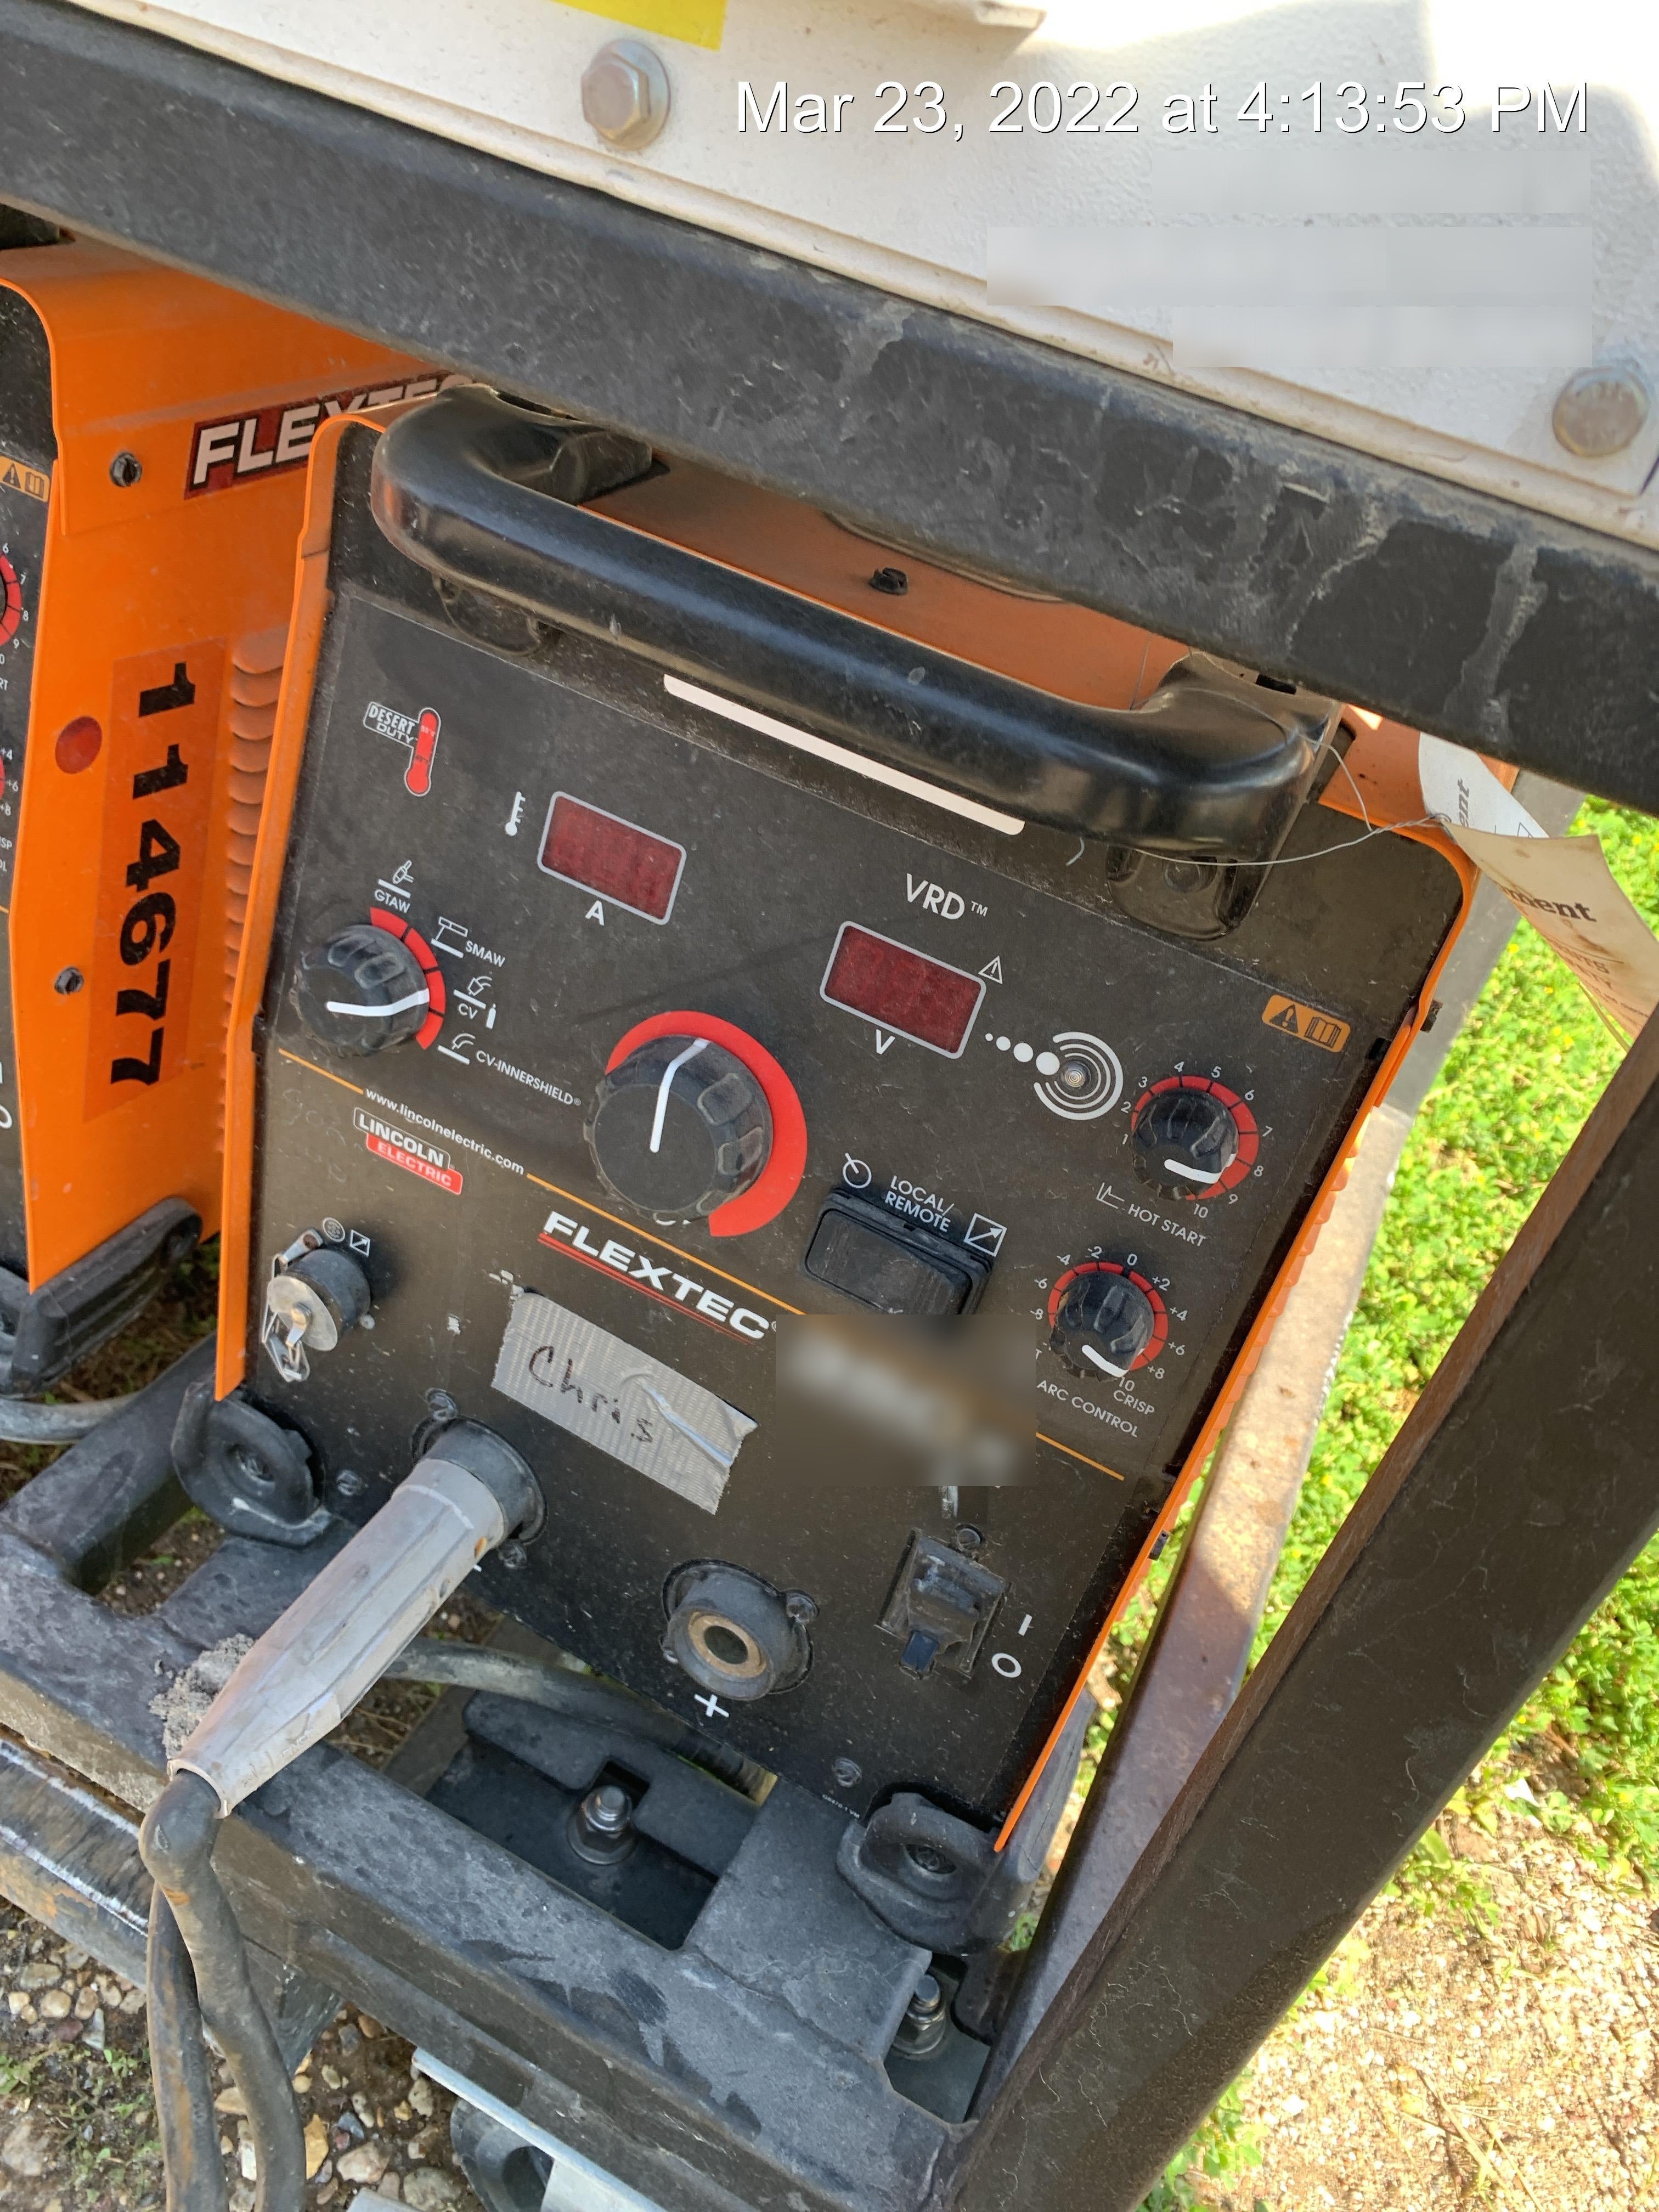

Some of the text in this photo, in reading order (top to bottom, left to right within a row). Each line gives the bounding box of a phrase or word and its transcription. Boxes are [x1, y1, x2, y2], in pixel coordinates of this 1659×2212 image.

[22, 611, 29, 622] 8
[13, 639, 20, 649] 9
[368, 705, 416, 735] DESERT
[111, 660, 196, 1085] 114677
[374, 888, 410, 914] GTAW
[585, 900, 605, 926] A
[465, 940, 506, 968] SMAW
[458, 1003, 478, 1019] CV
[876, 1029, 895, 1054] V
[1173, 1062, 1185, 1073] 4
[1211, 1066, 1222, 1078] 5
[1138, 1076, 1148, 1088] 3
[1244, 1090, 1255, 1101] 6
[1120, 1101, 1131, 1114] 2
[365, 1088, 524, 1175] www.lincolnelectric.com
[1262, 1125, 1273, 1137] 7
[359, 1113, 444, 1168] LINCOLN
[1122, 1133, 1128, 1145] 1
[377, 1141, 452, 1187] ELECTRIC
[1254, 1165, 1264, 1177] 8
[890, 1175, 955, 1216] LOCAL/
[1228, 1193, 1238, 1205] 9
[884, 1190, 951, 1232] REMOTE
[1193, 1203, 1209, 1218] 10
[1128, 1203, 1206, 1247] HOT START
[1056, 1254, 1071, 1266] -4
[1087, 1246, 1102, 1259] -2
[1127, 1253, 1138, 1266] 0
[1034, 1277, 1048, 1290] -6
[1152, 1276, 1171, 1291] +2
[1169, 1306, 1188, 1322] +4
[1167, 1341, 1186, 1356] +6
[1147, 1365, 1165, 1380] +8
[528, 1345, 653, 1444] Chris
[1113, 1389, 1155, 1415] CRISP
[1036, 1379, 1138, 1438] ARC CONTROL
